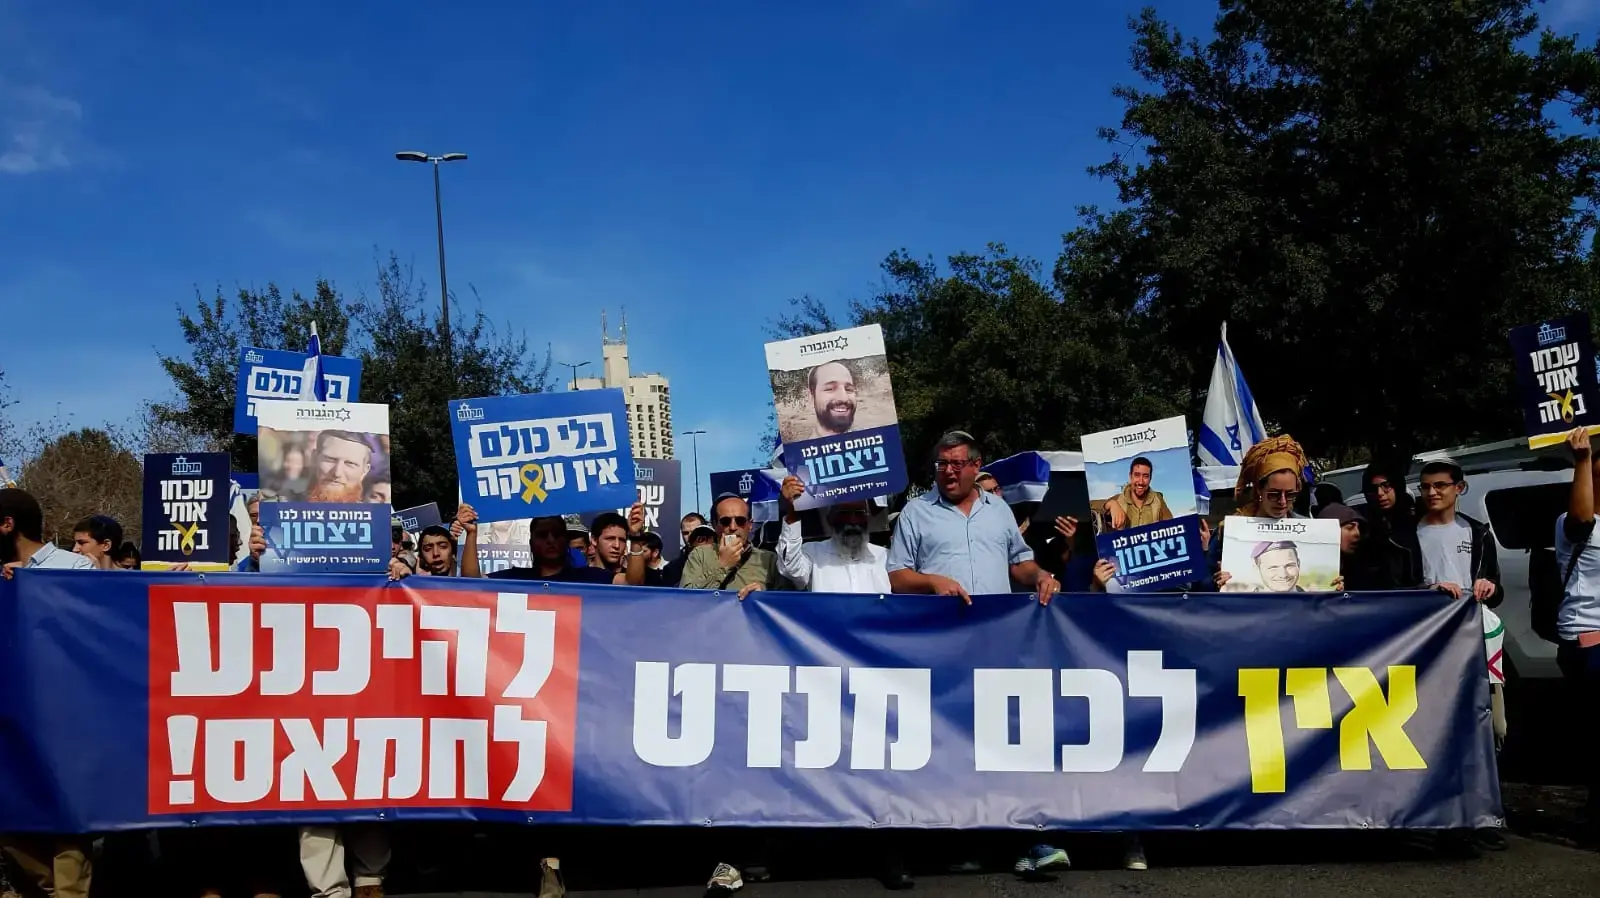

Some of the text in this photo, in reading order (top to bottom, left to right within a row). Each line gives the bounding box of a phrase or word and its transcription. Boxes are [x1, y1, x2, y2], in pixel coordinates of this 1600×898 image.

[800, 340, 834, 353] הגבורה
[1530, 342, 1580, 373] שכחו
[254, 370, 302, 394] כולם
[1537, 366, 1579, 393] אותי
[297, 409, 334, 417] הגבורה
[479, 418, 607, 458] בלי כולם
[801, 435, 884, 458] במותם ציוו לנו
[1112, 431, 1143, 445] הגבורה
[573, 457, 619, 492] אין
[160, 480, 213, 500] שכחו
[825, 487, 847, 497] אליהו
[850, 483, 873, 492] ידידיה
[163, 502, 207, 522] אותי
[279, 508, 372, 520] במותם ציוו לנו
[1112, 524, 1186, 549] במותם ציוו לנו
[1258, 523, 1291, 531] הגבורה
[287, 556, 326, 565] לוינשטיין
[477, 548, 488, 558] לנ
[1160, 570, 1181, 579] אריאל
[170, 593, 556, 698] להיכנע
[633, 650, 1428, 793] אין לכם מנדט
[167, 705, 548, 805] לחמאס!
